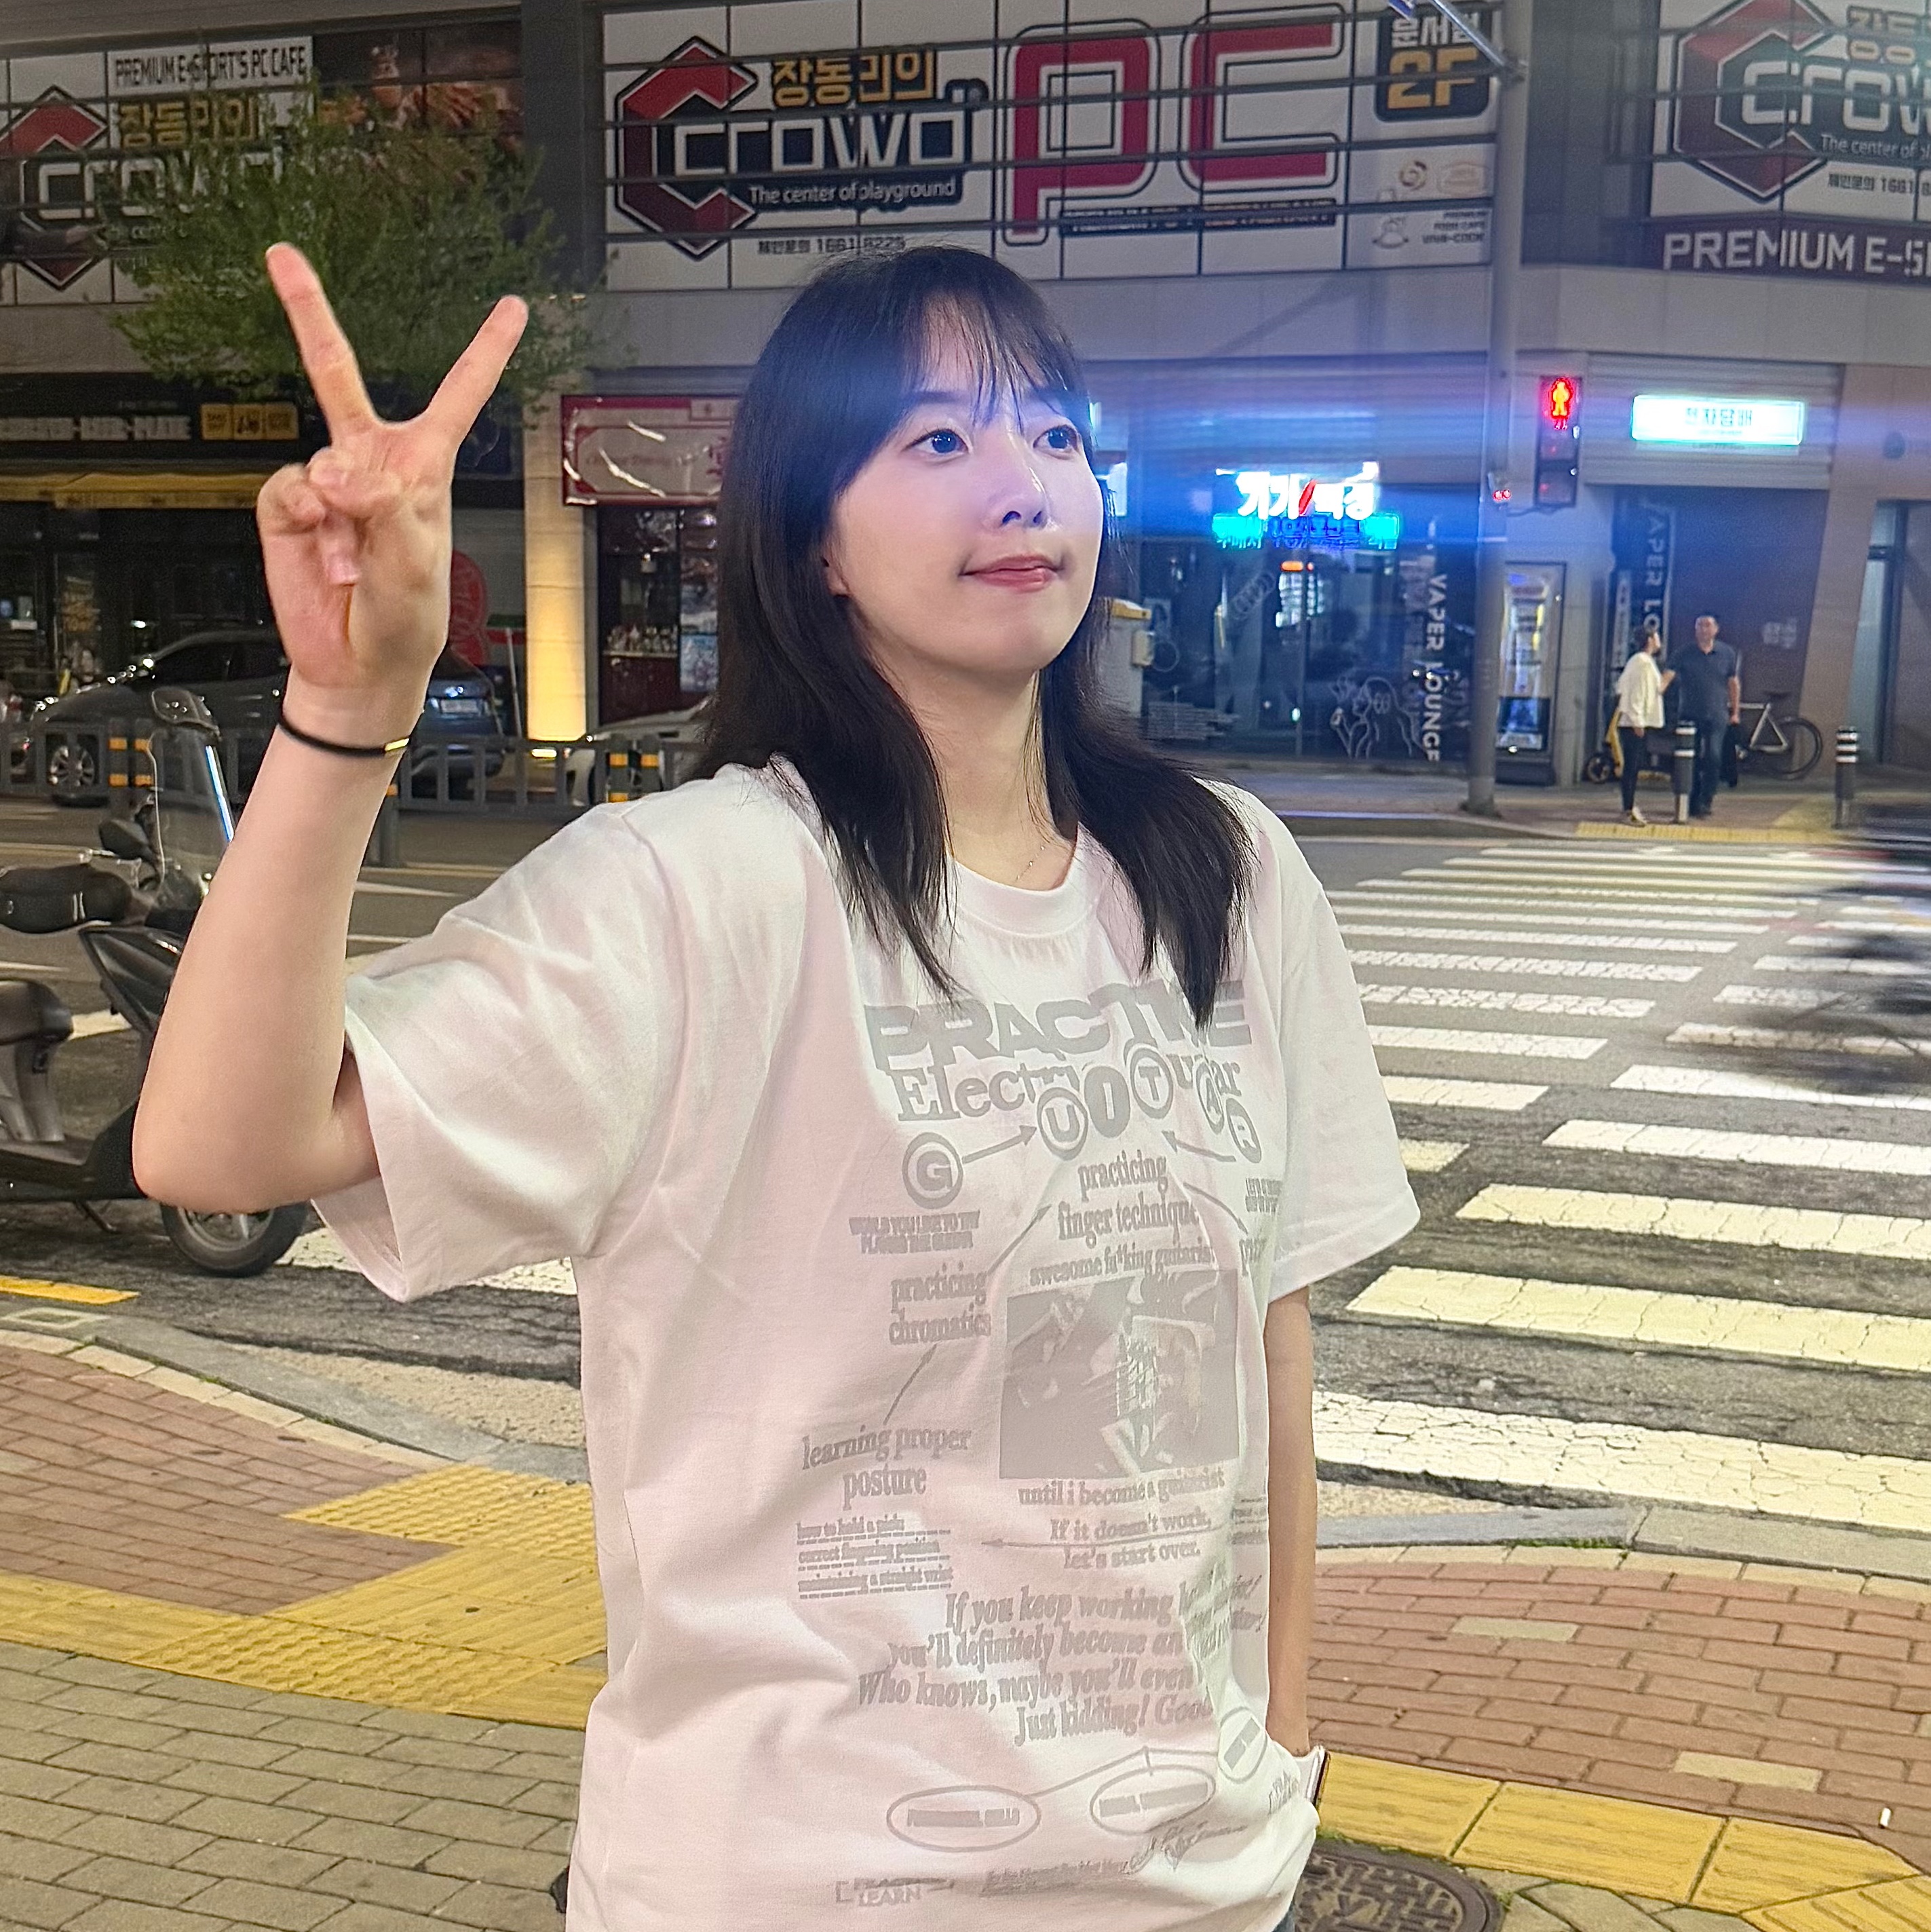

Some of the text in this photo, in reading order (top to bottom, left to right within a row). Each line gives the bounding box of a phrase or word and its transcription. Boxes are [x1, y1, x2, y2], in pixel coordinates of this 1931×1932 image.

[252, 48, 268, 77] PC
[271, 45, 307, 76] CAFE
[773, 50, 934, 107] 장동민의
[1388, 46, 1480, 109] 2F
[749, 186, 780, 204] The
[783, 185, 836, 203] center
[838, 179, 857, 201] of
[1662, 229, 1931, 277] PREMIUM E-S
[1426, 574, 1447, 651] VAPER
[864, 979, 1252, 1071] PRACTIE
[1077, 1149, 1168, 1202] practicing
[1058, 1200, 1112, 1249] finger
[891, 1261, 988, 1314] practicing
[1030, 1257, 1102, 1287] awesome
[802, 1424, 972, 1471] learning proper
[843, 1463, 927, 1511] posture
[1018, 1480, 1063, 1506] until
[1050, 1518, 1070, 1540] If
[1073, 1519, 1090, 1540] it
[1111, 1544, 1155, 1568] start
[1159, 1542, 1201, 1559] over.
[946, 1591, 970, 1635] If
[970, 1597, 1014, 1635] you
[1019, 1585, 1072, 1627] keep
[1079, 1587, 1174, 1627] working
[887, 1631, 953, 1671] you'll
[956, 1623, 1055, 1673] definitely
[1059, 1620, 1147, 1656] become
[858, 1657, 1194, 1713] Who knows, maybe you'll even
[1014, 1706, 1057, 1747] Just
[1059, 1693, 1150, 1737] kidding!
